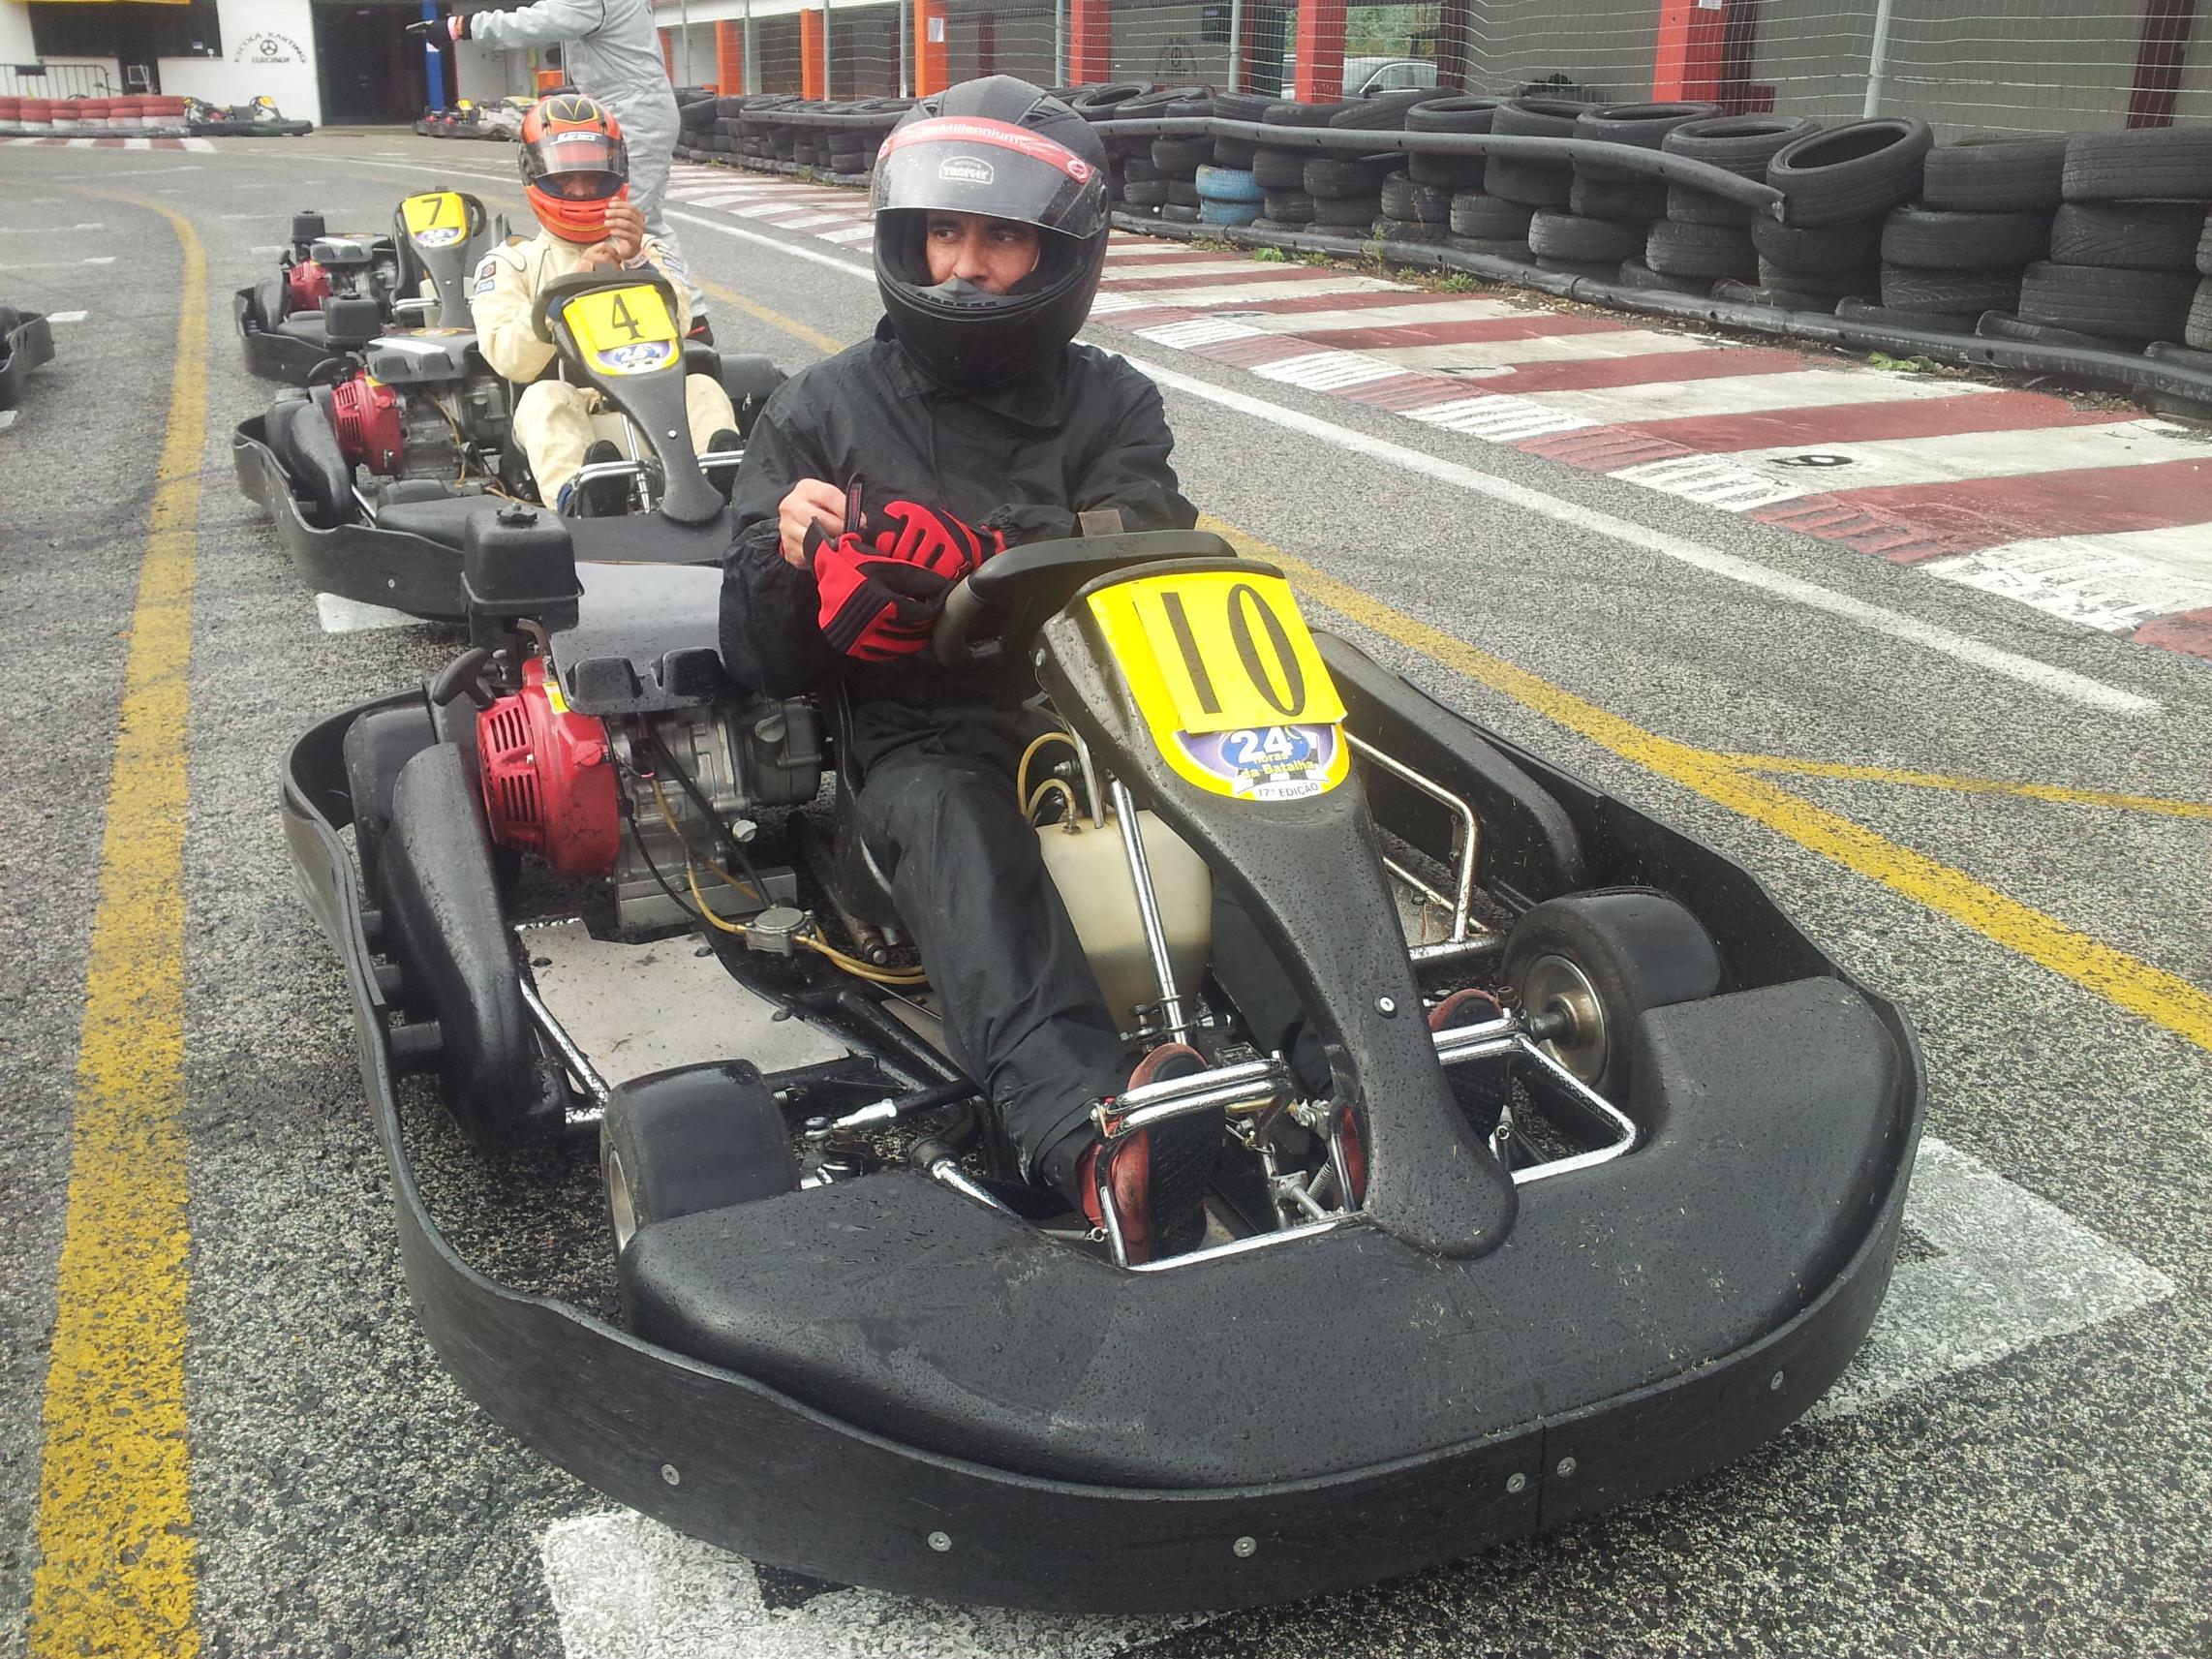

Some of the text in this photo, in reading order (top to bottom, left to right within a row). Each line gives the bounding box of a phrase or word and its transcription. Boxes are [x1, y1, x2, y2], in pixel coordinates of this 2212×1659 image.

[268, 32, 306, 64] KARTING
[938, 123, 1021, 146] Millennium
[421, 197, 443, 227] 7
[612, 293, 645, 340] 4
[1159, 583, 1306, 717] 10
[1230, 726, 1294, 764] 24
[1241, 758, 1316, 780] da Batalha
[1278, 780, 1319, 798] EDIÇÃO
